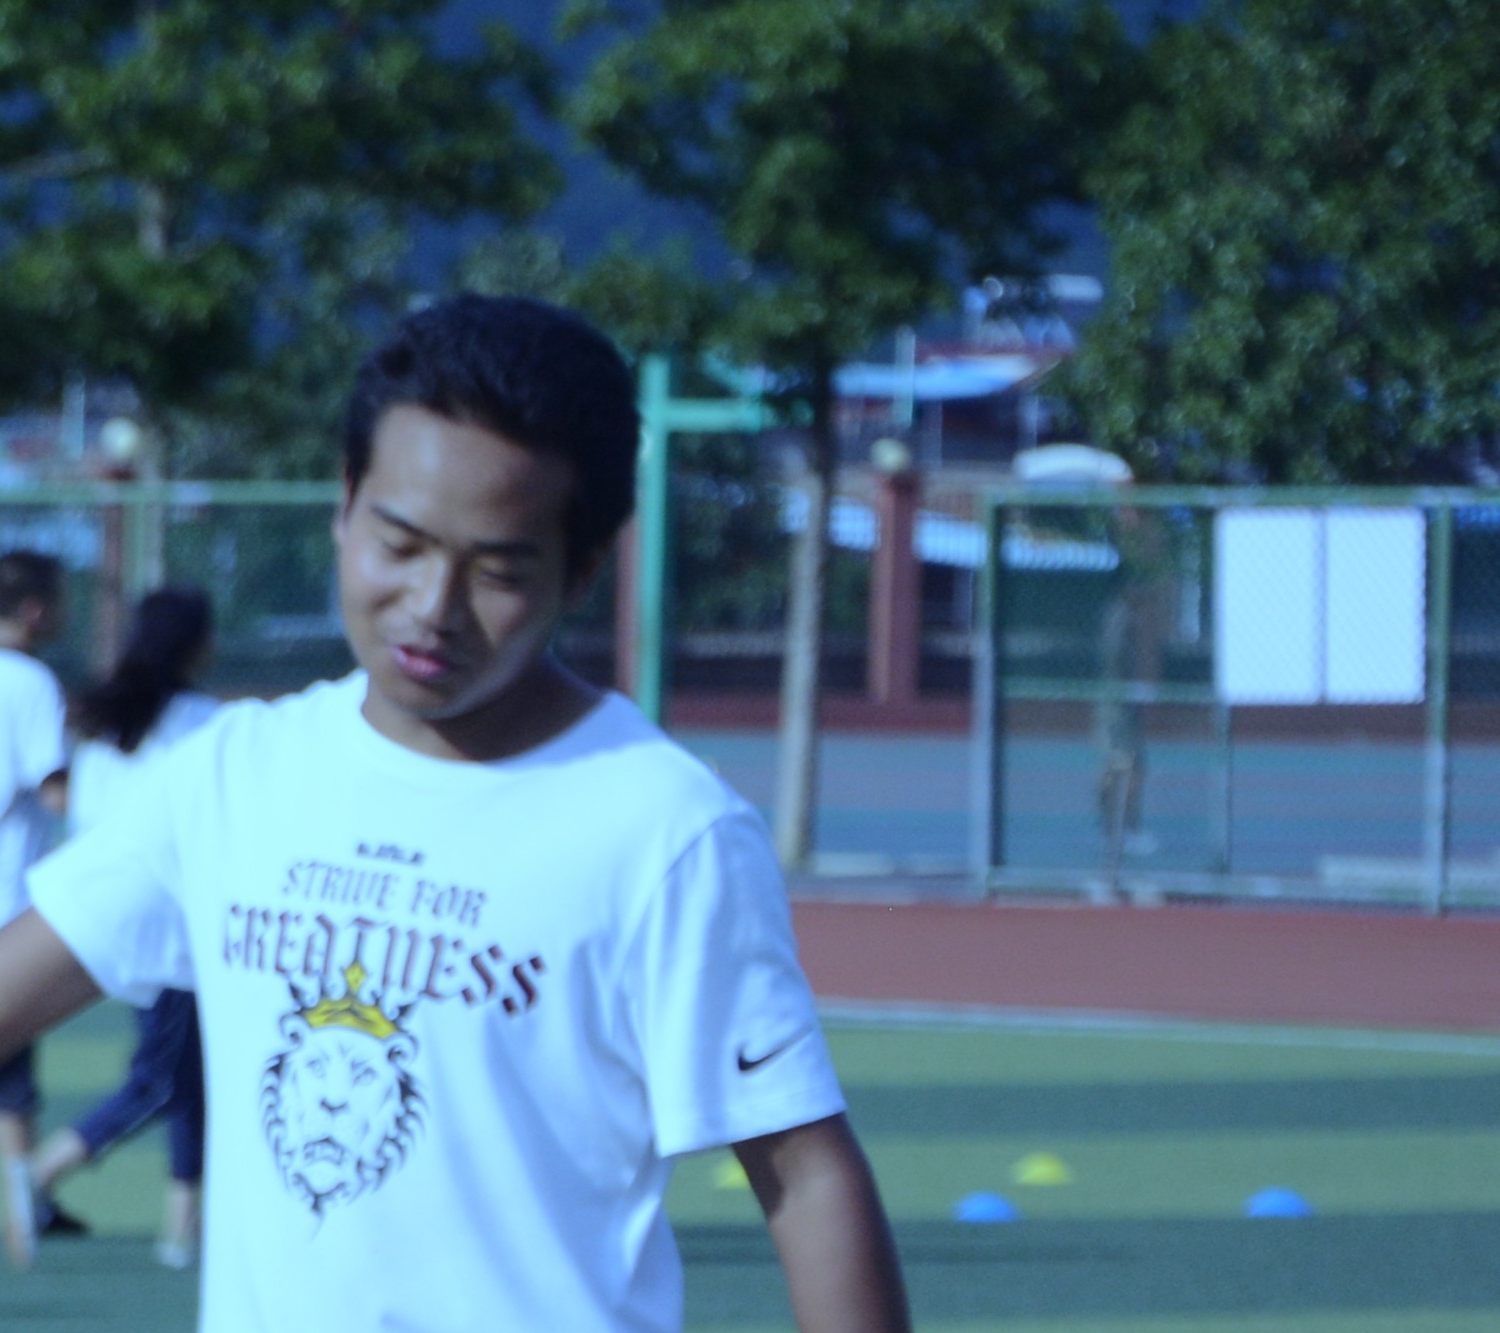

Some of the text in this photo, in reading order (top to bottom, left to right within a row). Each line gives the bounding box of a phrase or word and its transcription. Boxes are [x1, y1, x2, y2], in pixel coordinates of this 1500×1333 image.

[282, 861, 487, 927] STRIVE FOR
[223, 903, 547, 1015] GREATNESS
